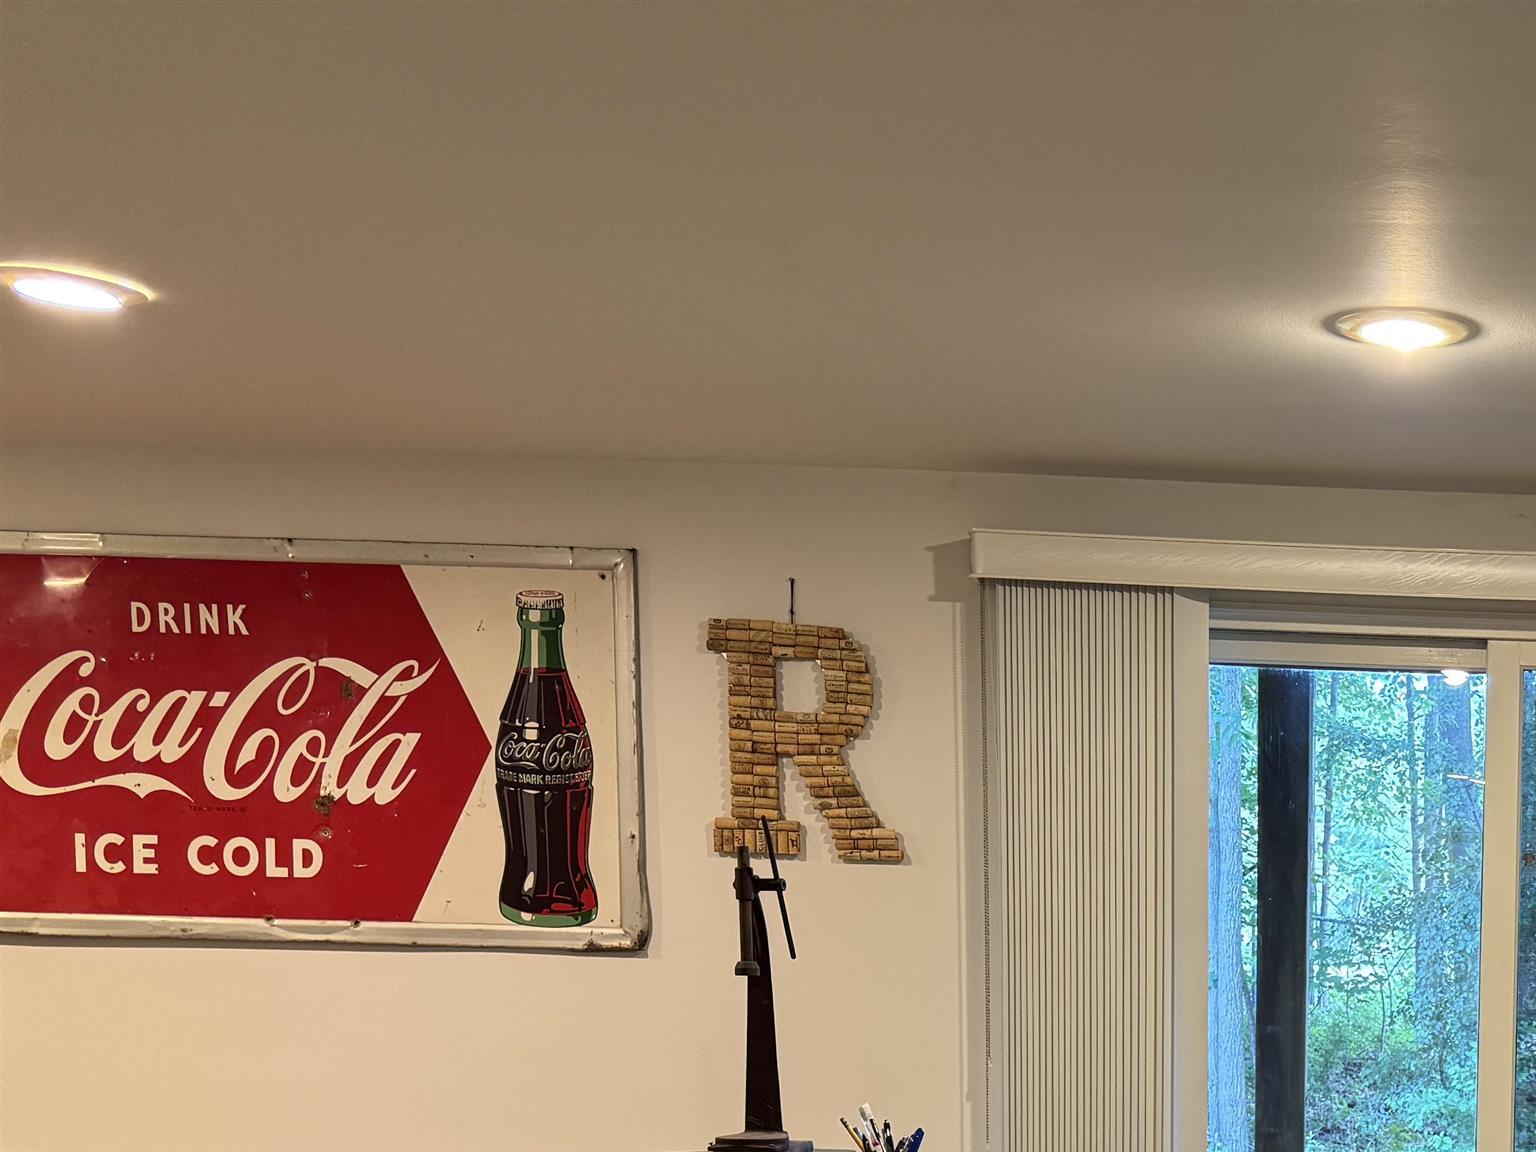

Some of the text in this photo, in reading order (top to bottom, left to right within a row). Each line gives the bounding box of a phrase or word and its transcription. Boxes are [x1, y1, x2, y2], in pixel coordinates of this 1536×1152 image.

[131, 600, 251, 636] DRINK
[0, 649, 441, 806] Coca-Cola
[498, 731, 592, 771] Coca-Cola
[518, 773, 544, 785] MARK
[74, 832, 325, 879] ICE COLD
